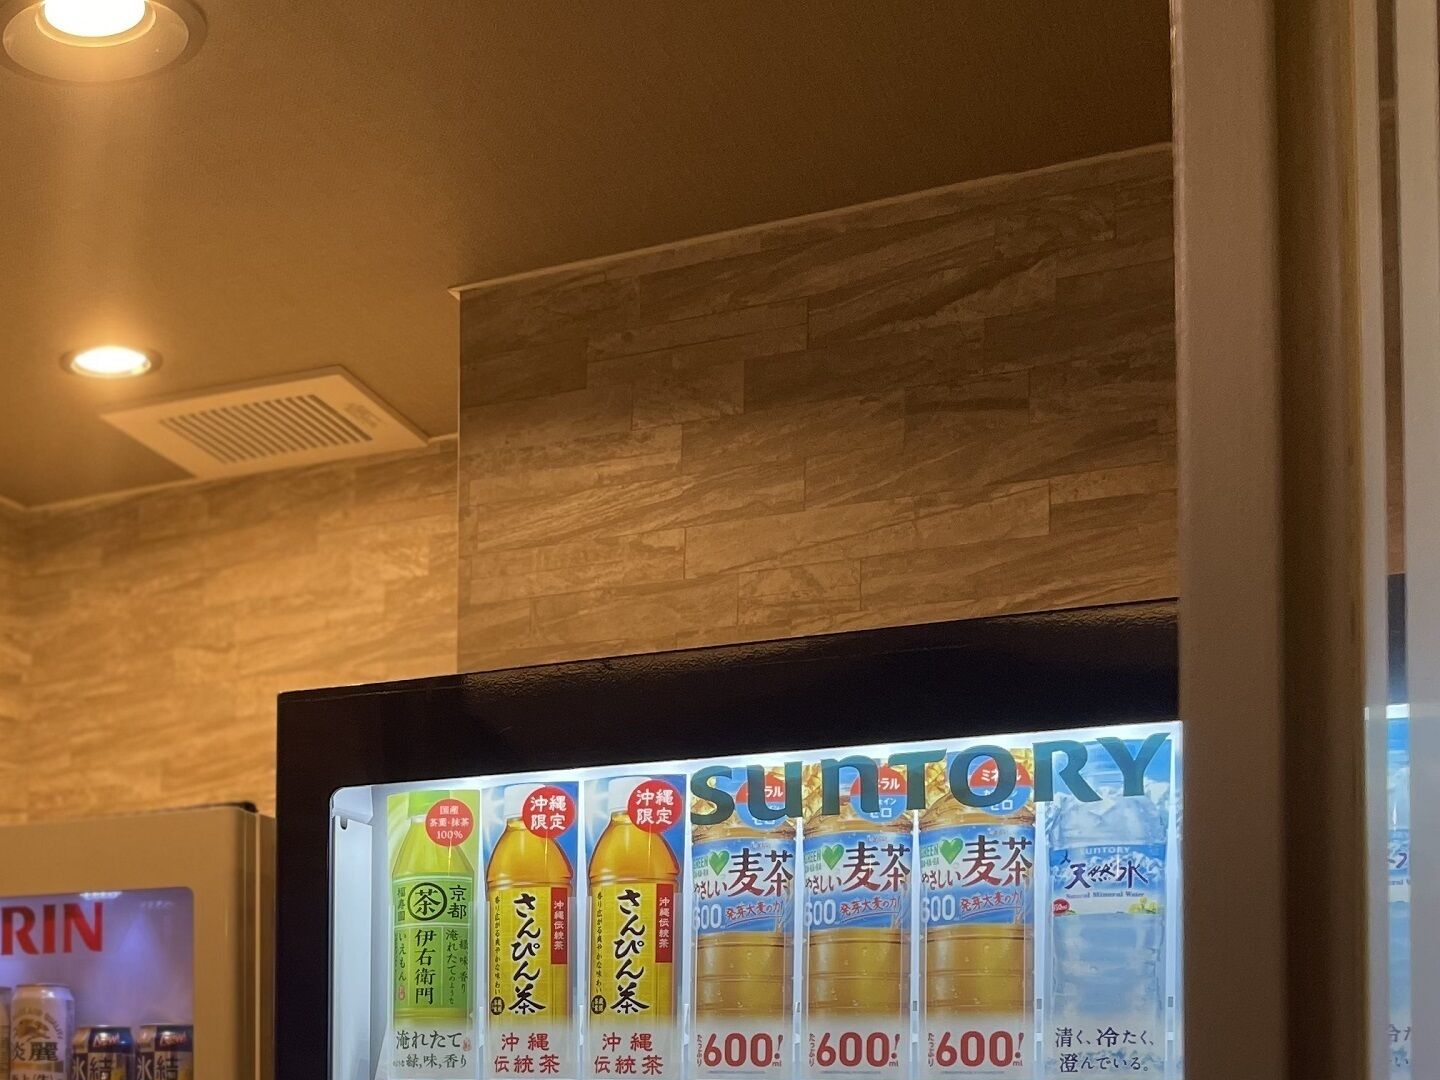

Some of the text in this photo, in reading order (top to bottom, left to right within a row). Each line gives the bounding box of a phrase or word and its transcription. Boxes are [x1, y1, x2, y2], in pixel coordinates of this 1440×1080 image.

[530, 795, 568, 812] 沖縄
[636, 788, 674, 806] 沖縄
[530, 813, 567, 831] 限定
[636, 807, 673, 825] 限定
[436, 829, 463, 840] 100%
[843, 841, 910, 893] 麦茶
[962, 834, 1033, 887] 麦茶
[727, 848, 793, 897] 麦茶
[1064, 860, 1149, 890] 天然水
[447, 884, 467, 920] 京都
[553, 900, 565, 950] 沖縄伝統茶
[658, 897, 670, 949] 沖縄伝統茶
[508, 892, 547, 1015] さんぴん茶
[610, 889, 650, 1015] さんぴん茶
[414, 929, 437, 1006] 伊右衛門
[395, 1029, 462, 1050] 淹れたて
[501, 1032, 551, 1051] 沖縄
[602, 1032, 653, 1051] 沖縄
[1055, 1027, 1154, 1047] 清く、冷たく、
[494, 1054, 560, 1075] 伝統茶
[594, 1055, 663, 1076] 伝統茶
[1059, 1053, 1149, 1072] 澄んでいる。
